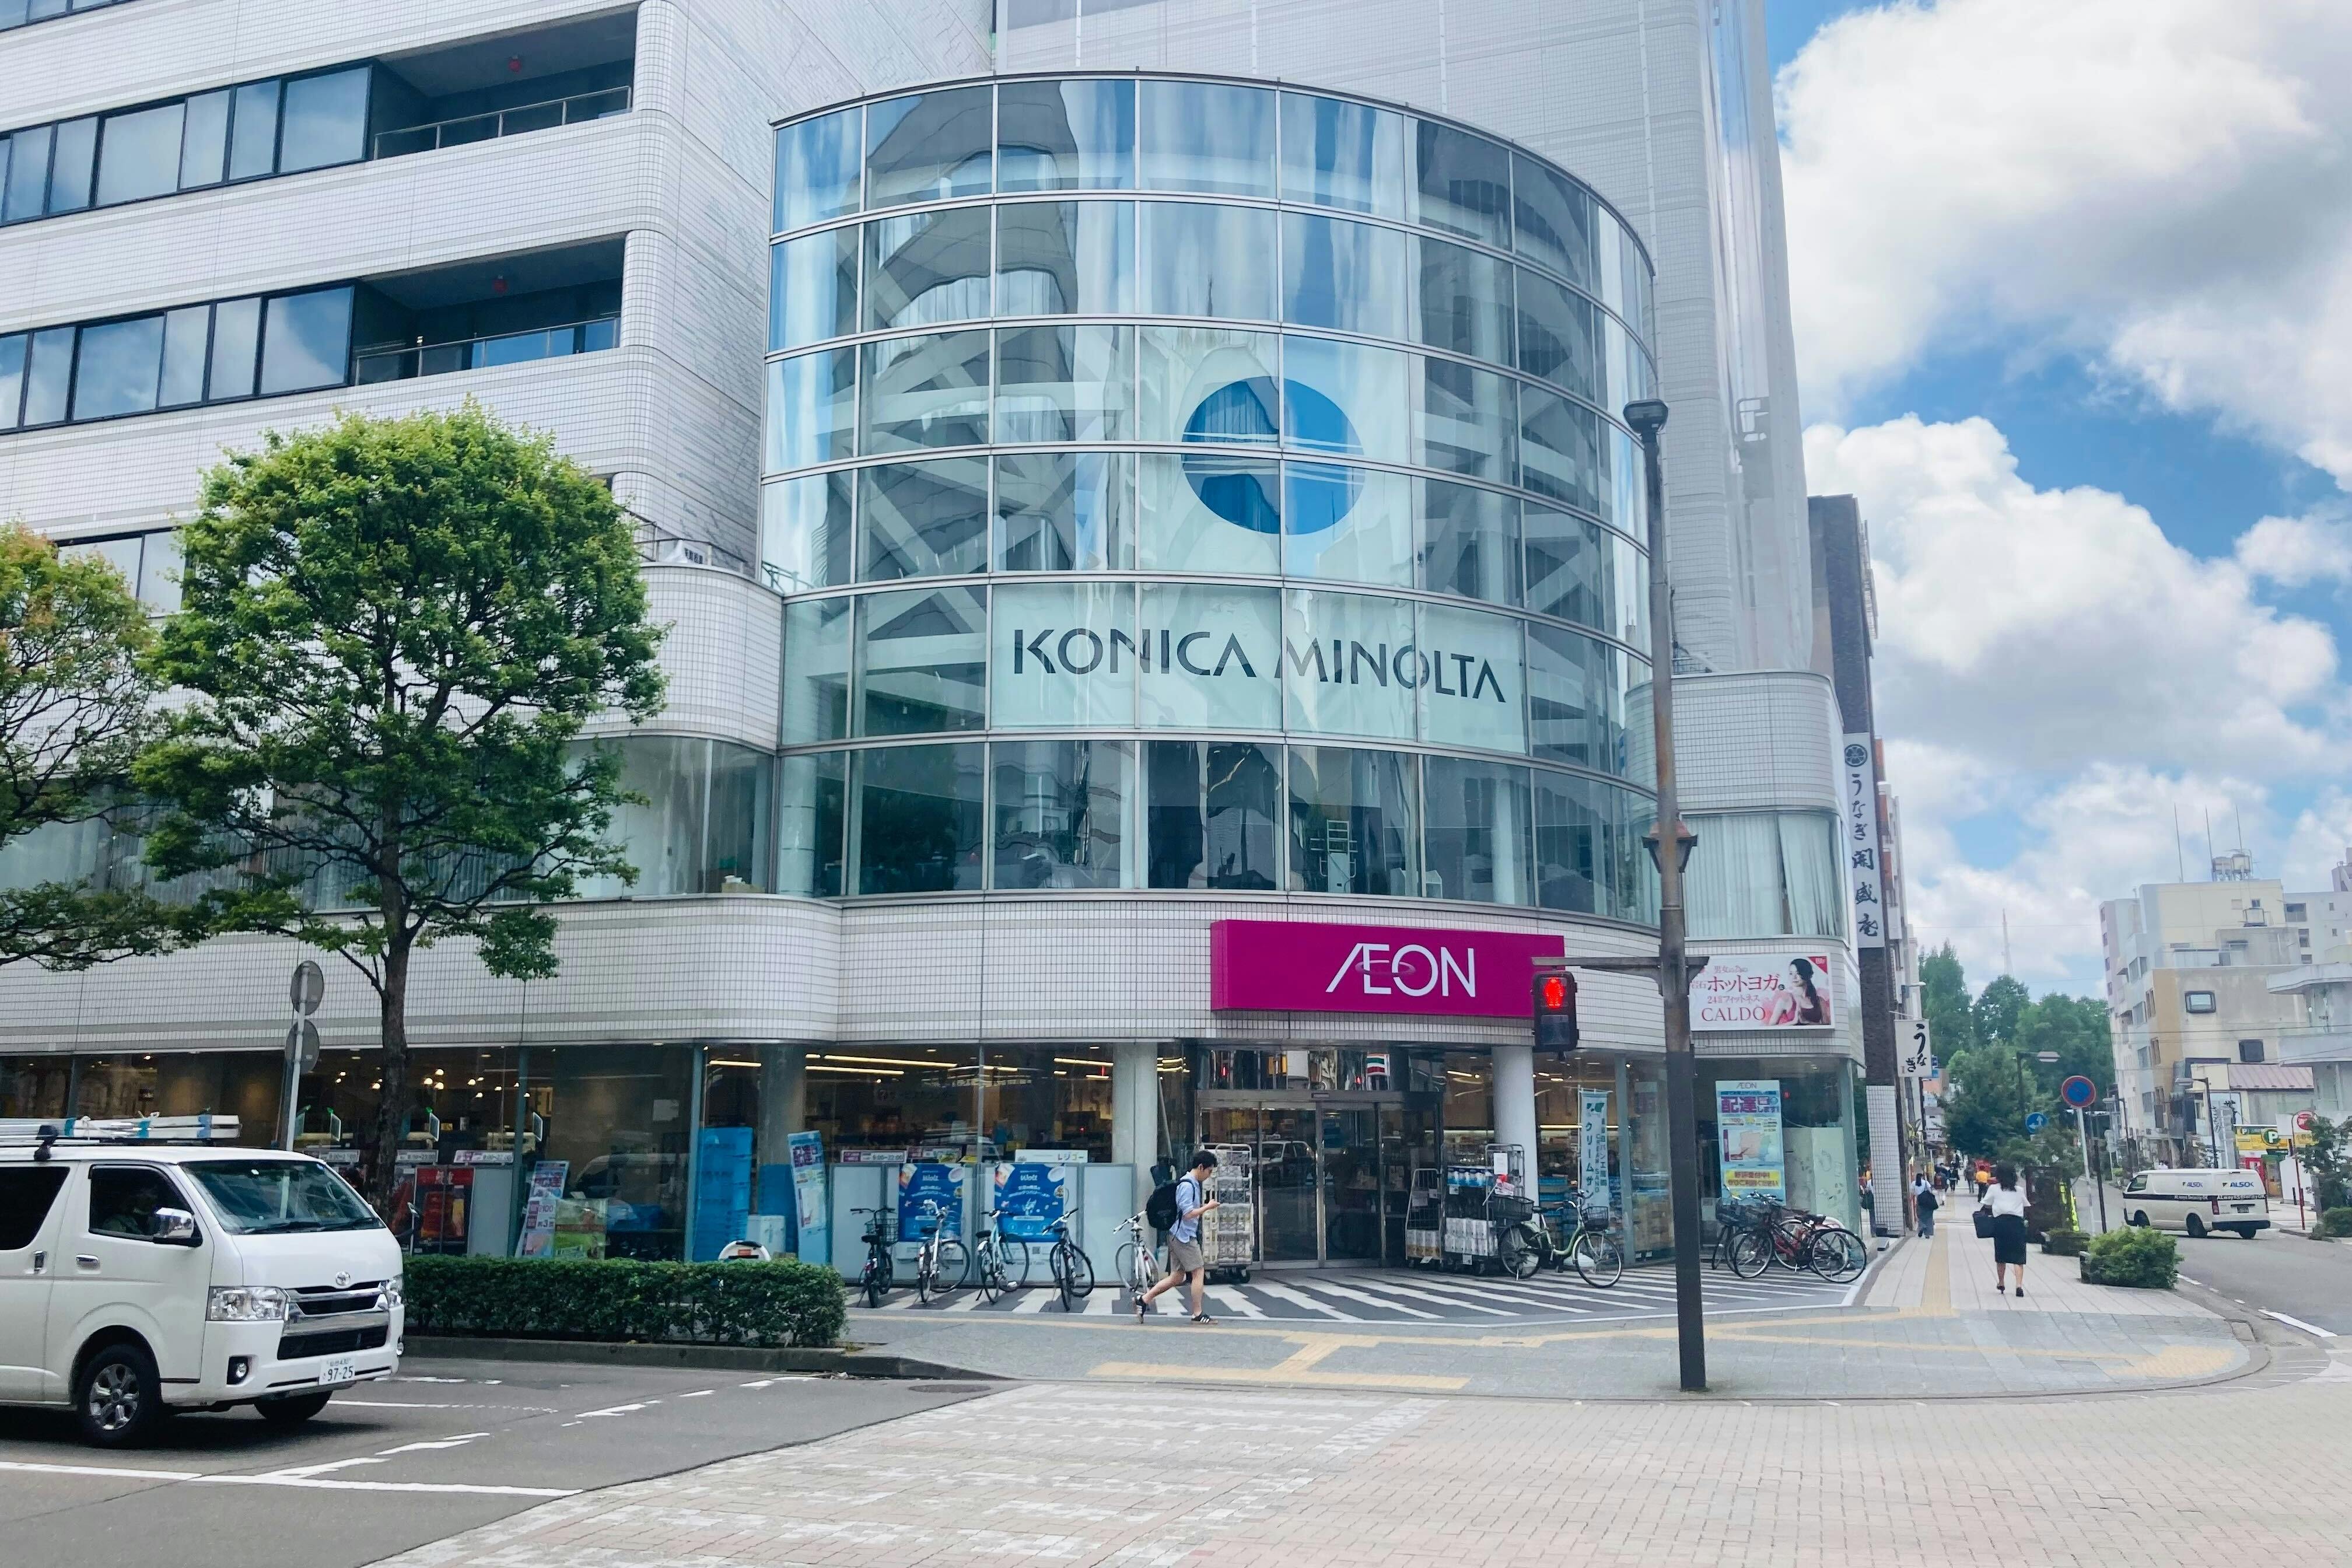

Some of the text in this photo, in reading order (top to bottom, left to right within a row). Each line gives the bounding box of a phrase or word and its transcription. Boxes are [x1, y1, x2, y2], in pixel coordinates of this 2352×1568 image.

[1014, 628, 1506, 703] KONICA MINOLTA
[1701, 1006, 1766, 1021] CALDO
[1905, 1023, 1927, 1073] うなぎ
[2268, 1131, 2278, 1143] P
[328, 1366, 354, 1381] 97-25
